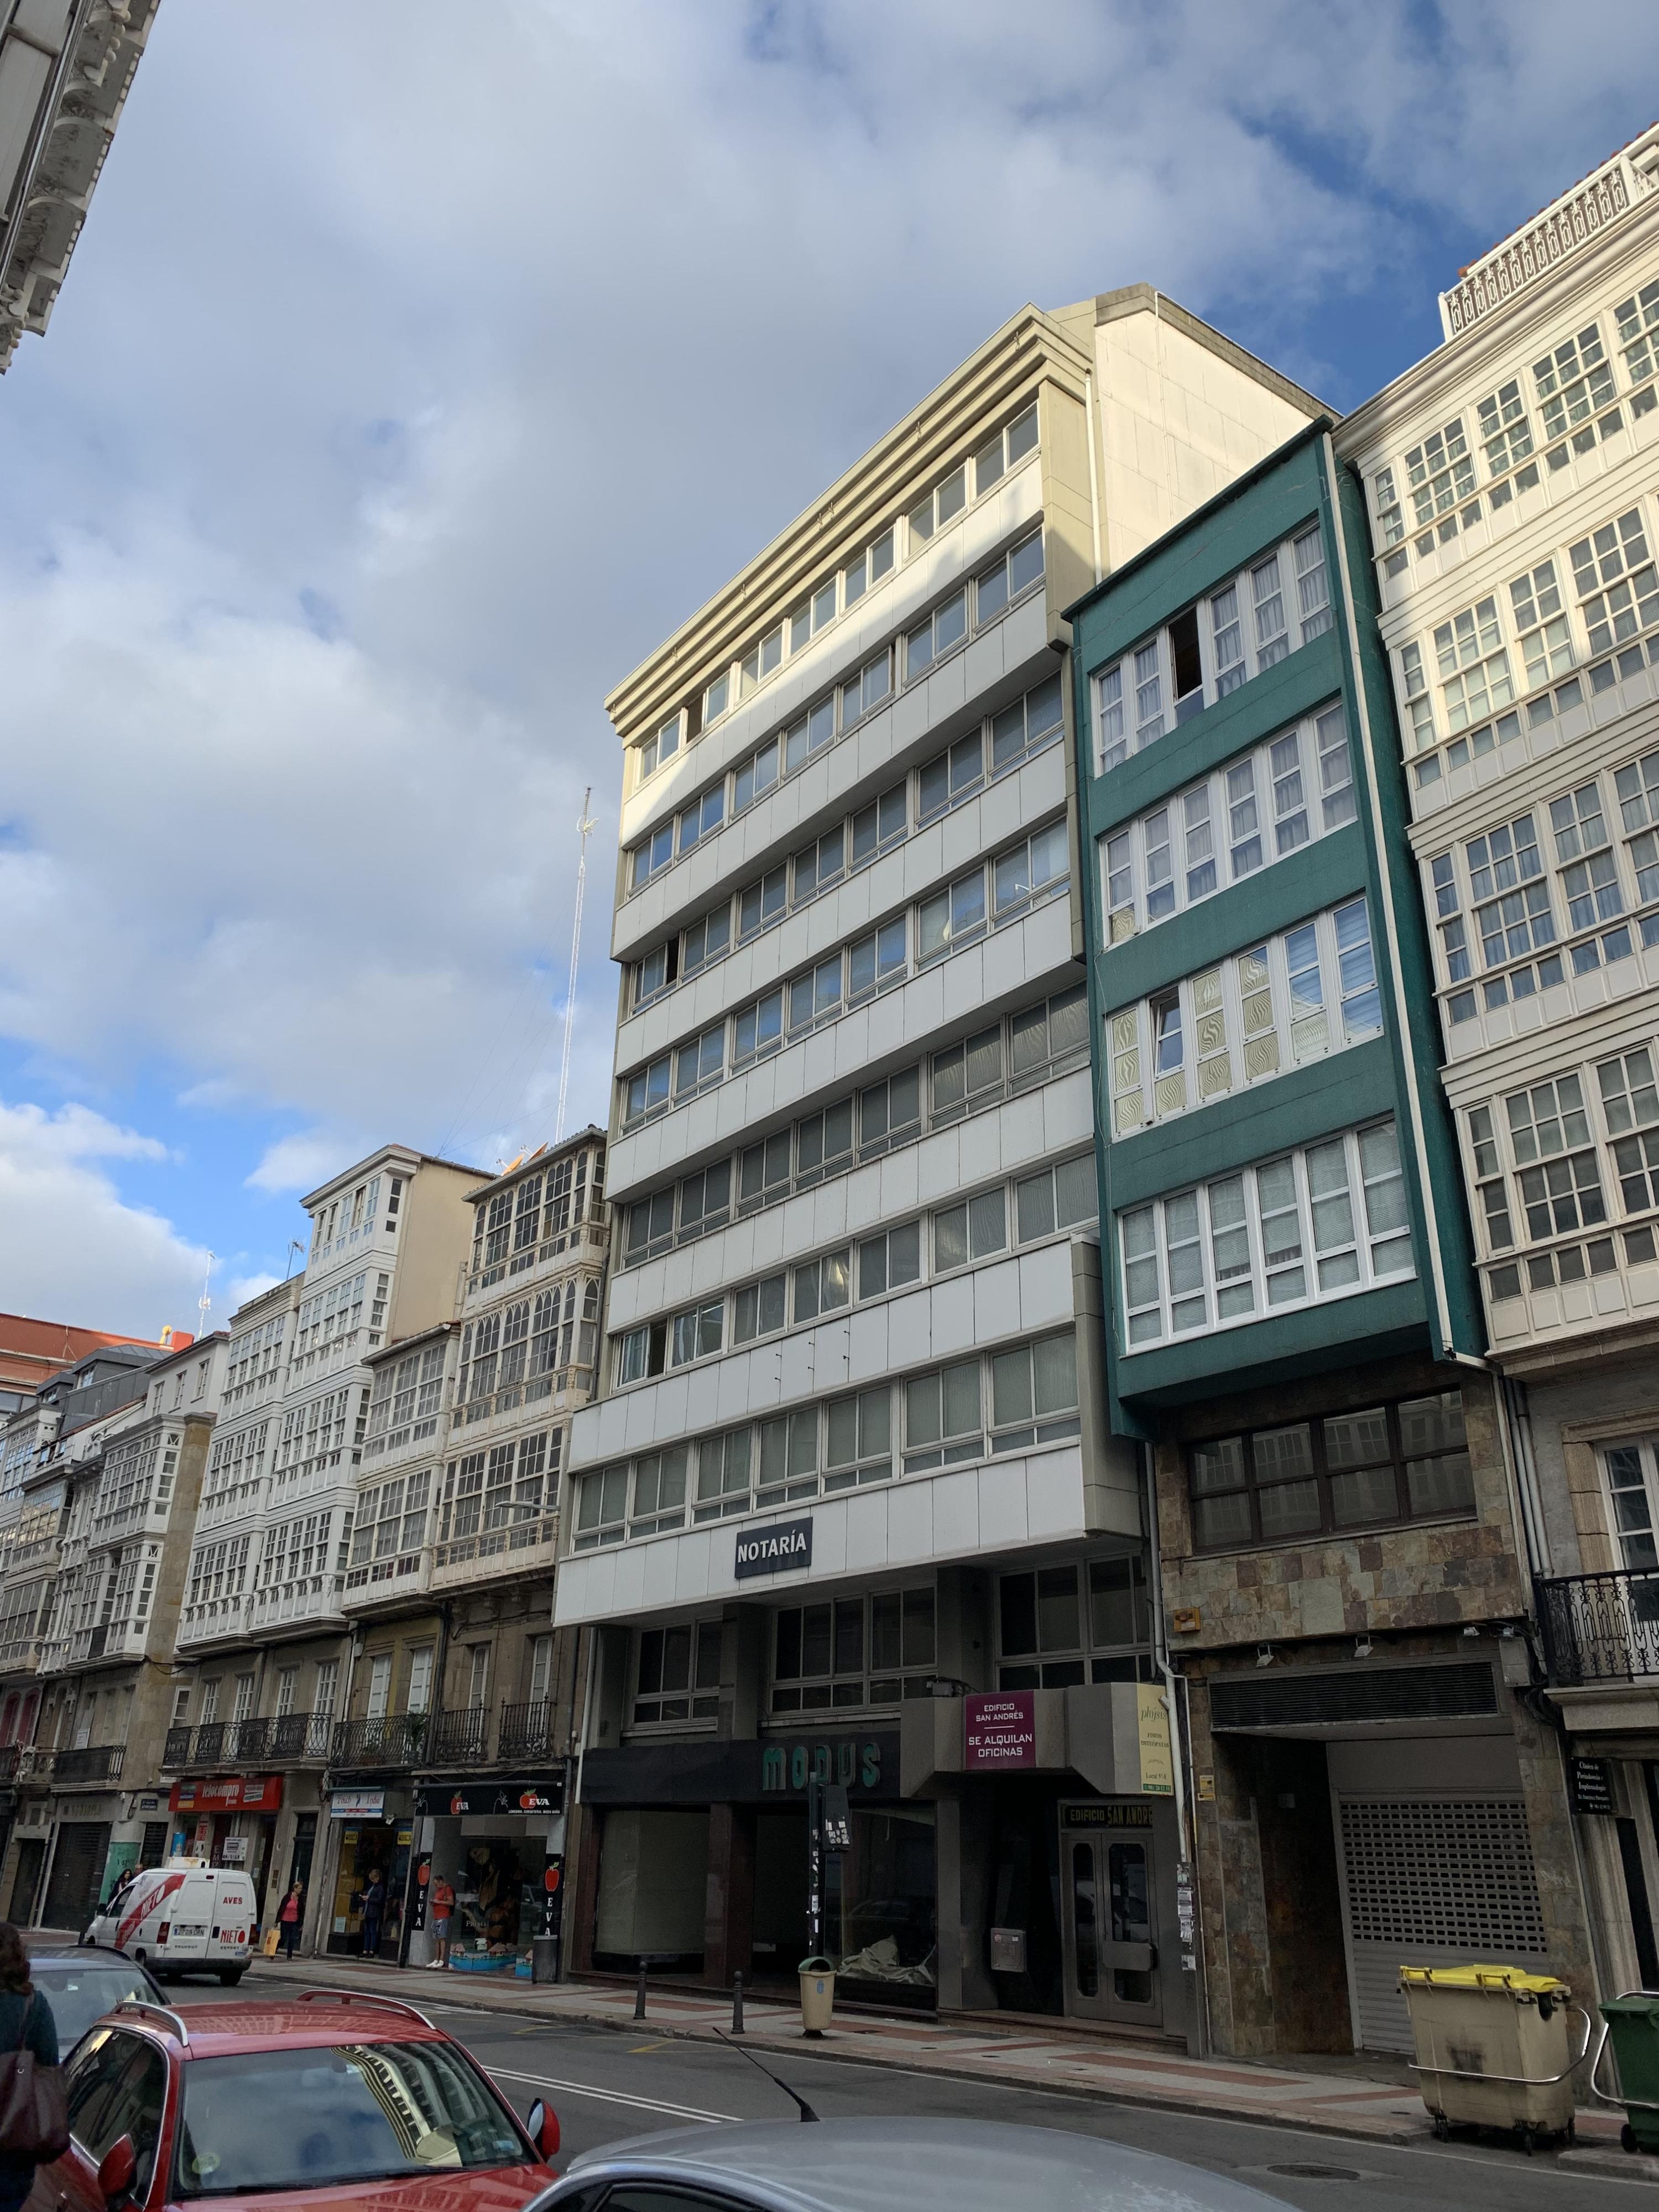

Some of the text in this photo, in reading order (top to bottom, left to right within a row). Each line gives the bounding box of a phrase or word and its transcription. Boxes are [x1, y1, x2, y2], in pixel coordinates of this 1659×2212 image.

[738, 1529, 807, 1563] NOTARÍA
[984, 1703, 1015, 1712] EDIFICIO
[993, 1710, 1024, 1721] ANDRÉS
[968, 1733, 1032, 1746] SE ALQUILAN
[978, 1747, 1023, 1757] OFICINAS
[763, 1742, 881, 1791] MODUS
[456, 1802, 469, 1810] EVA
[1071, 1809, 1105, 1822] EDIFICIO
[1107, 1806, 1123, 1825] SAN
[415, 1890, 425, 1927] EVA
[544, 1897, 553, 1936] EVA
